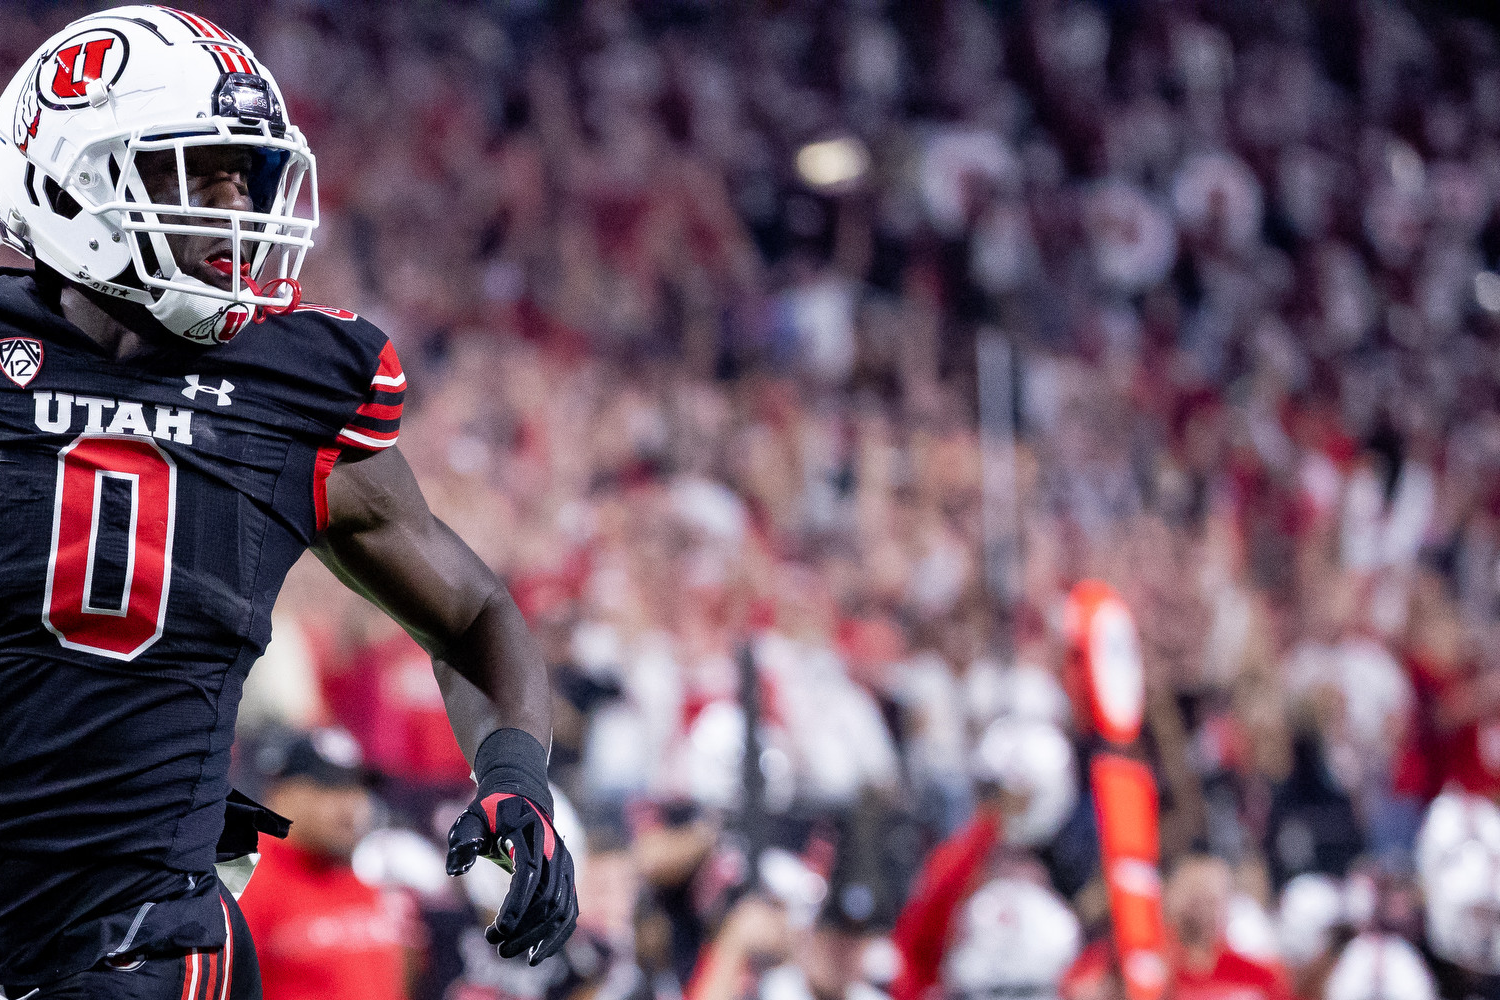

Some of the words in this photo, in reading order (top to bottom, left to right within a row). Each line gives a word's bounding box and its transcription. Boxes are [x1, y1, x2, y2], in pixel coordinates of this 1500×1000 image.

[51, 38, 115, 99] U
[0, 339, 41, 369] PAC
[10, 360, 33, 377] 12
[33, 390, 195, 445] UTAH
[42, 433, 177, 662] 0
